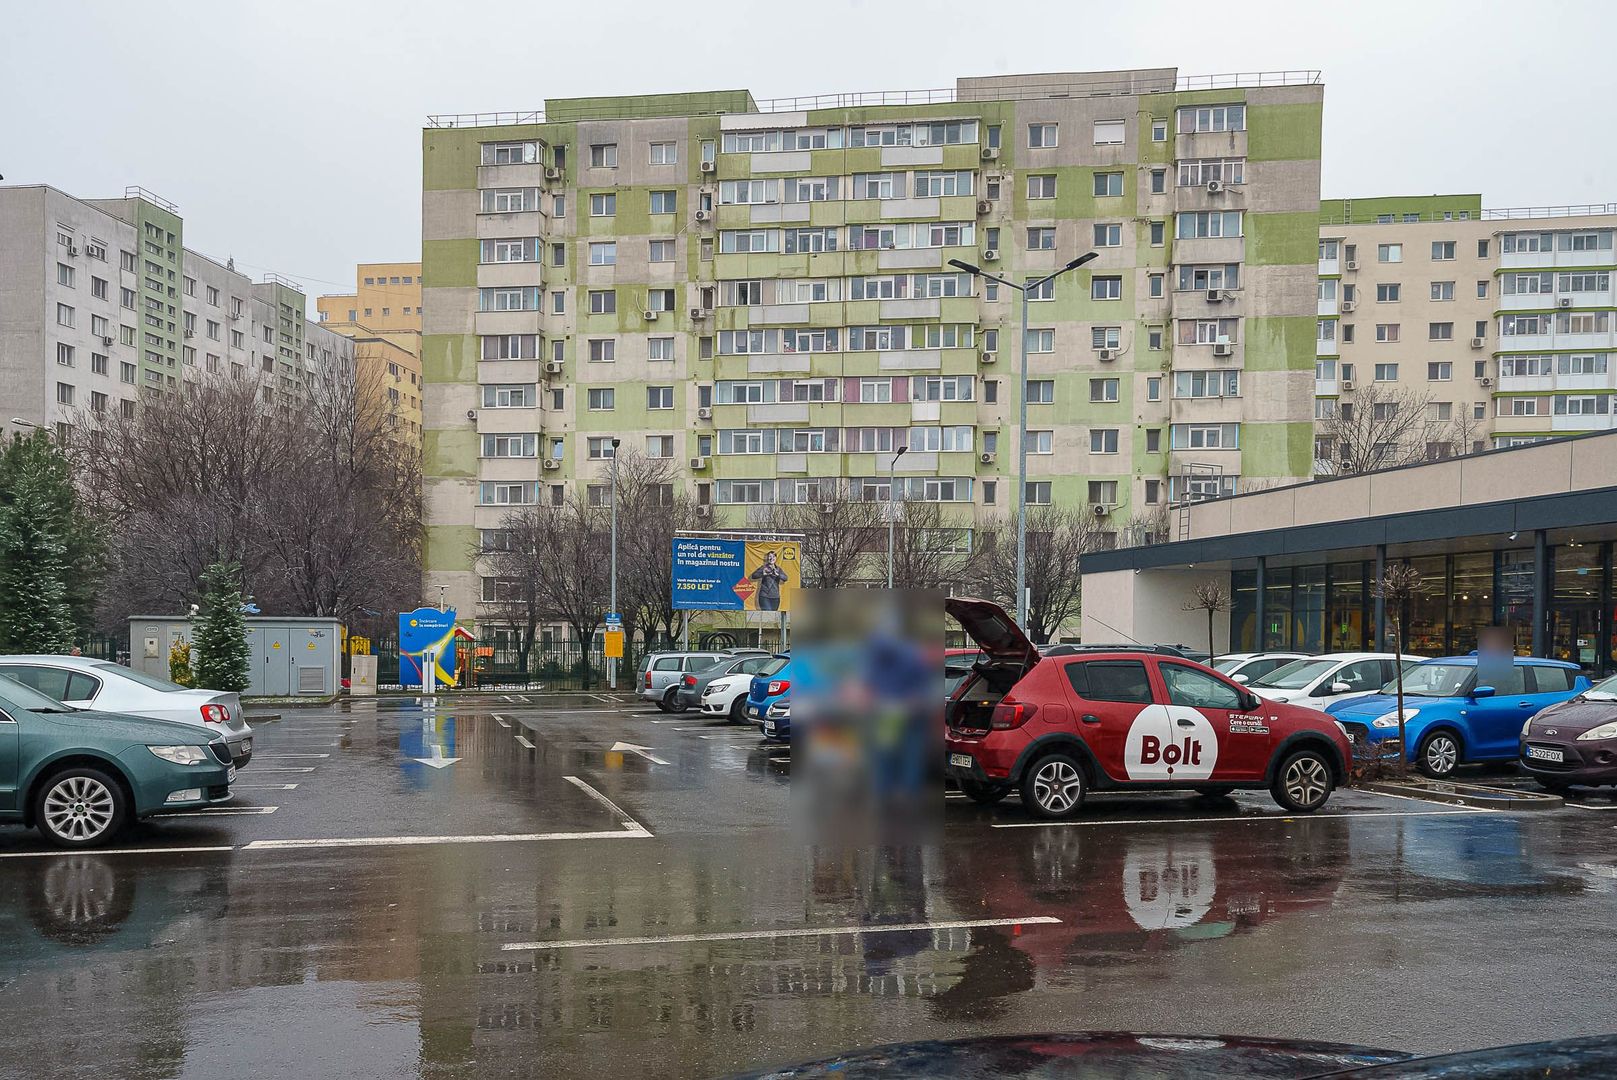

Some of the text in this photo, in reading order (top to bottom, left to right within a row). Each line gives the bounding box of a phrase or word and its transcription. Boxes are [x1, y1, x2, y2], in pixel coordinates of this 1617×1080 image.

[677, 543, 698, 551] Aplică
[685, 559, 718, 567] magazinul
[1140, 735, 1202, 766] Bolt
